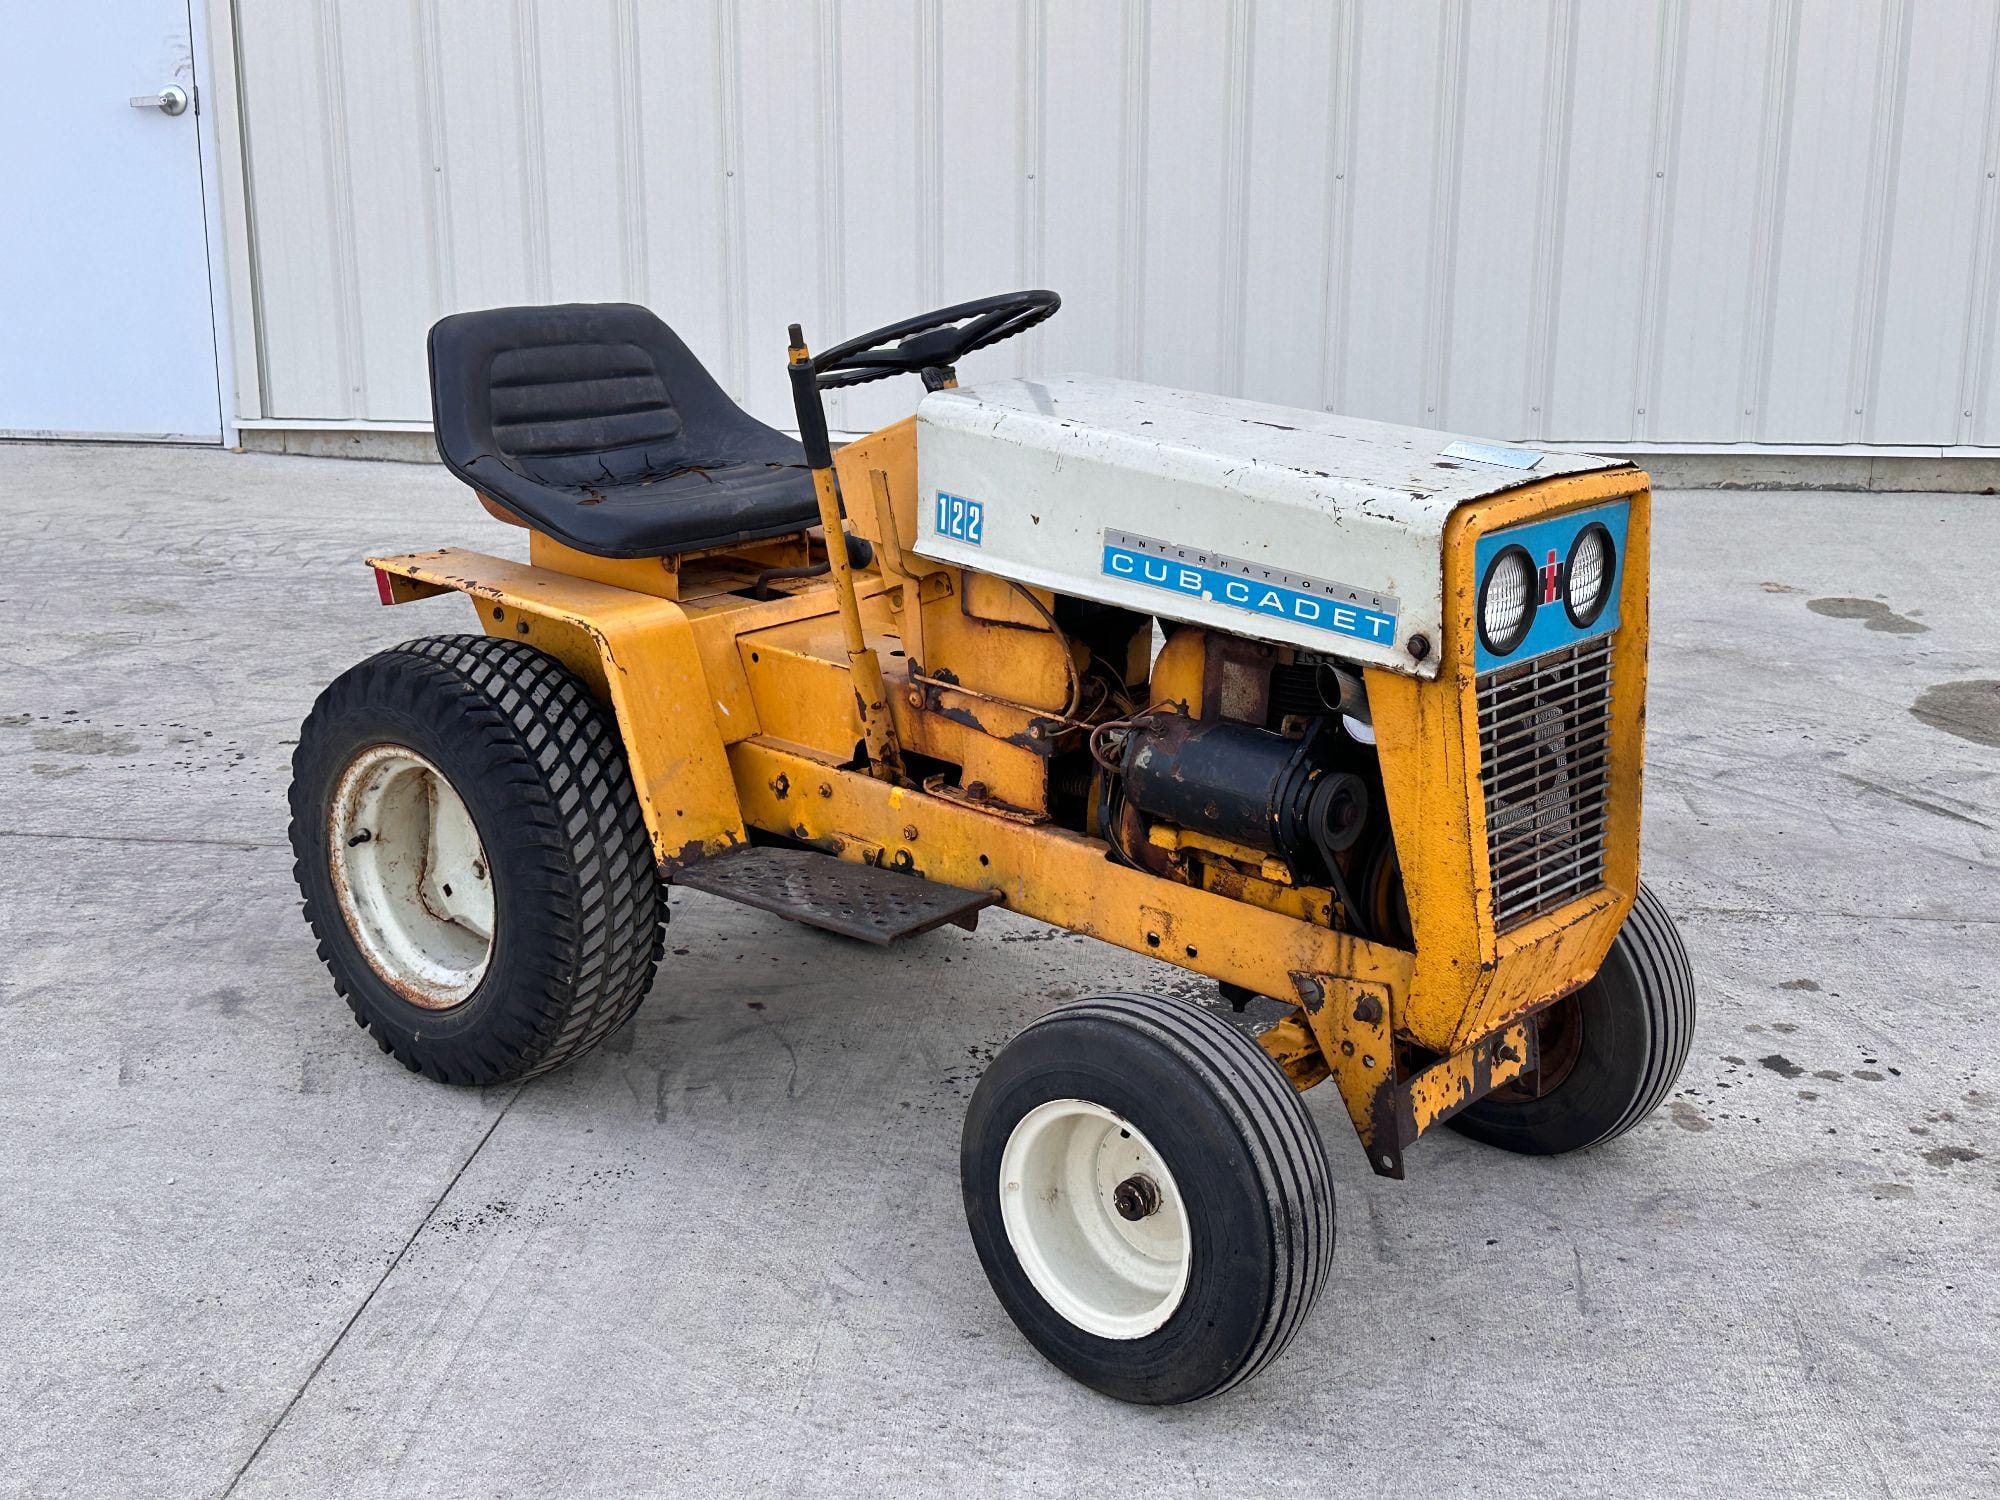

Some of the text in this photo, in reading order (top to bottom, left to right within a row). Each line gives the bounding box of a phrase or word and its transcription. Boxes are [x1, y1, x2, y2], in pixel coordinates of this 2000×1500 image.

[939, 497, 980, 540] 122
[1111, 553, 1391, 637] CUB CADET
[1121, 536, 1381, 607] INTERNATIONAL
